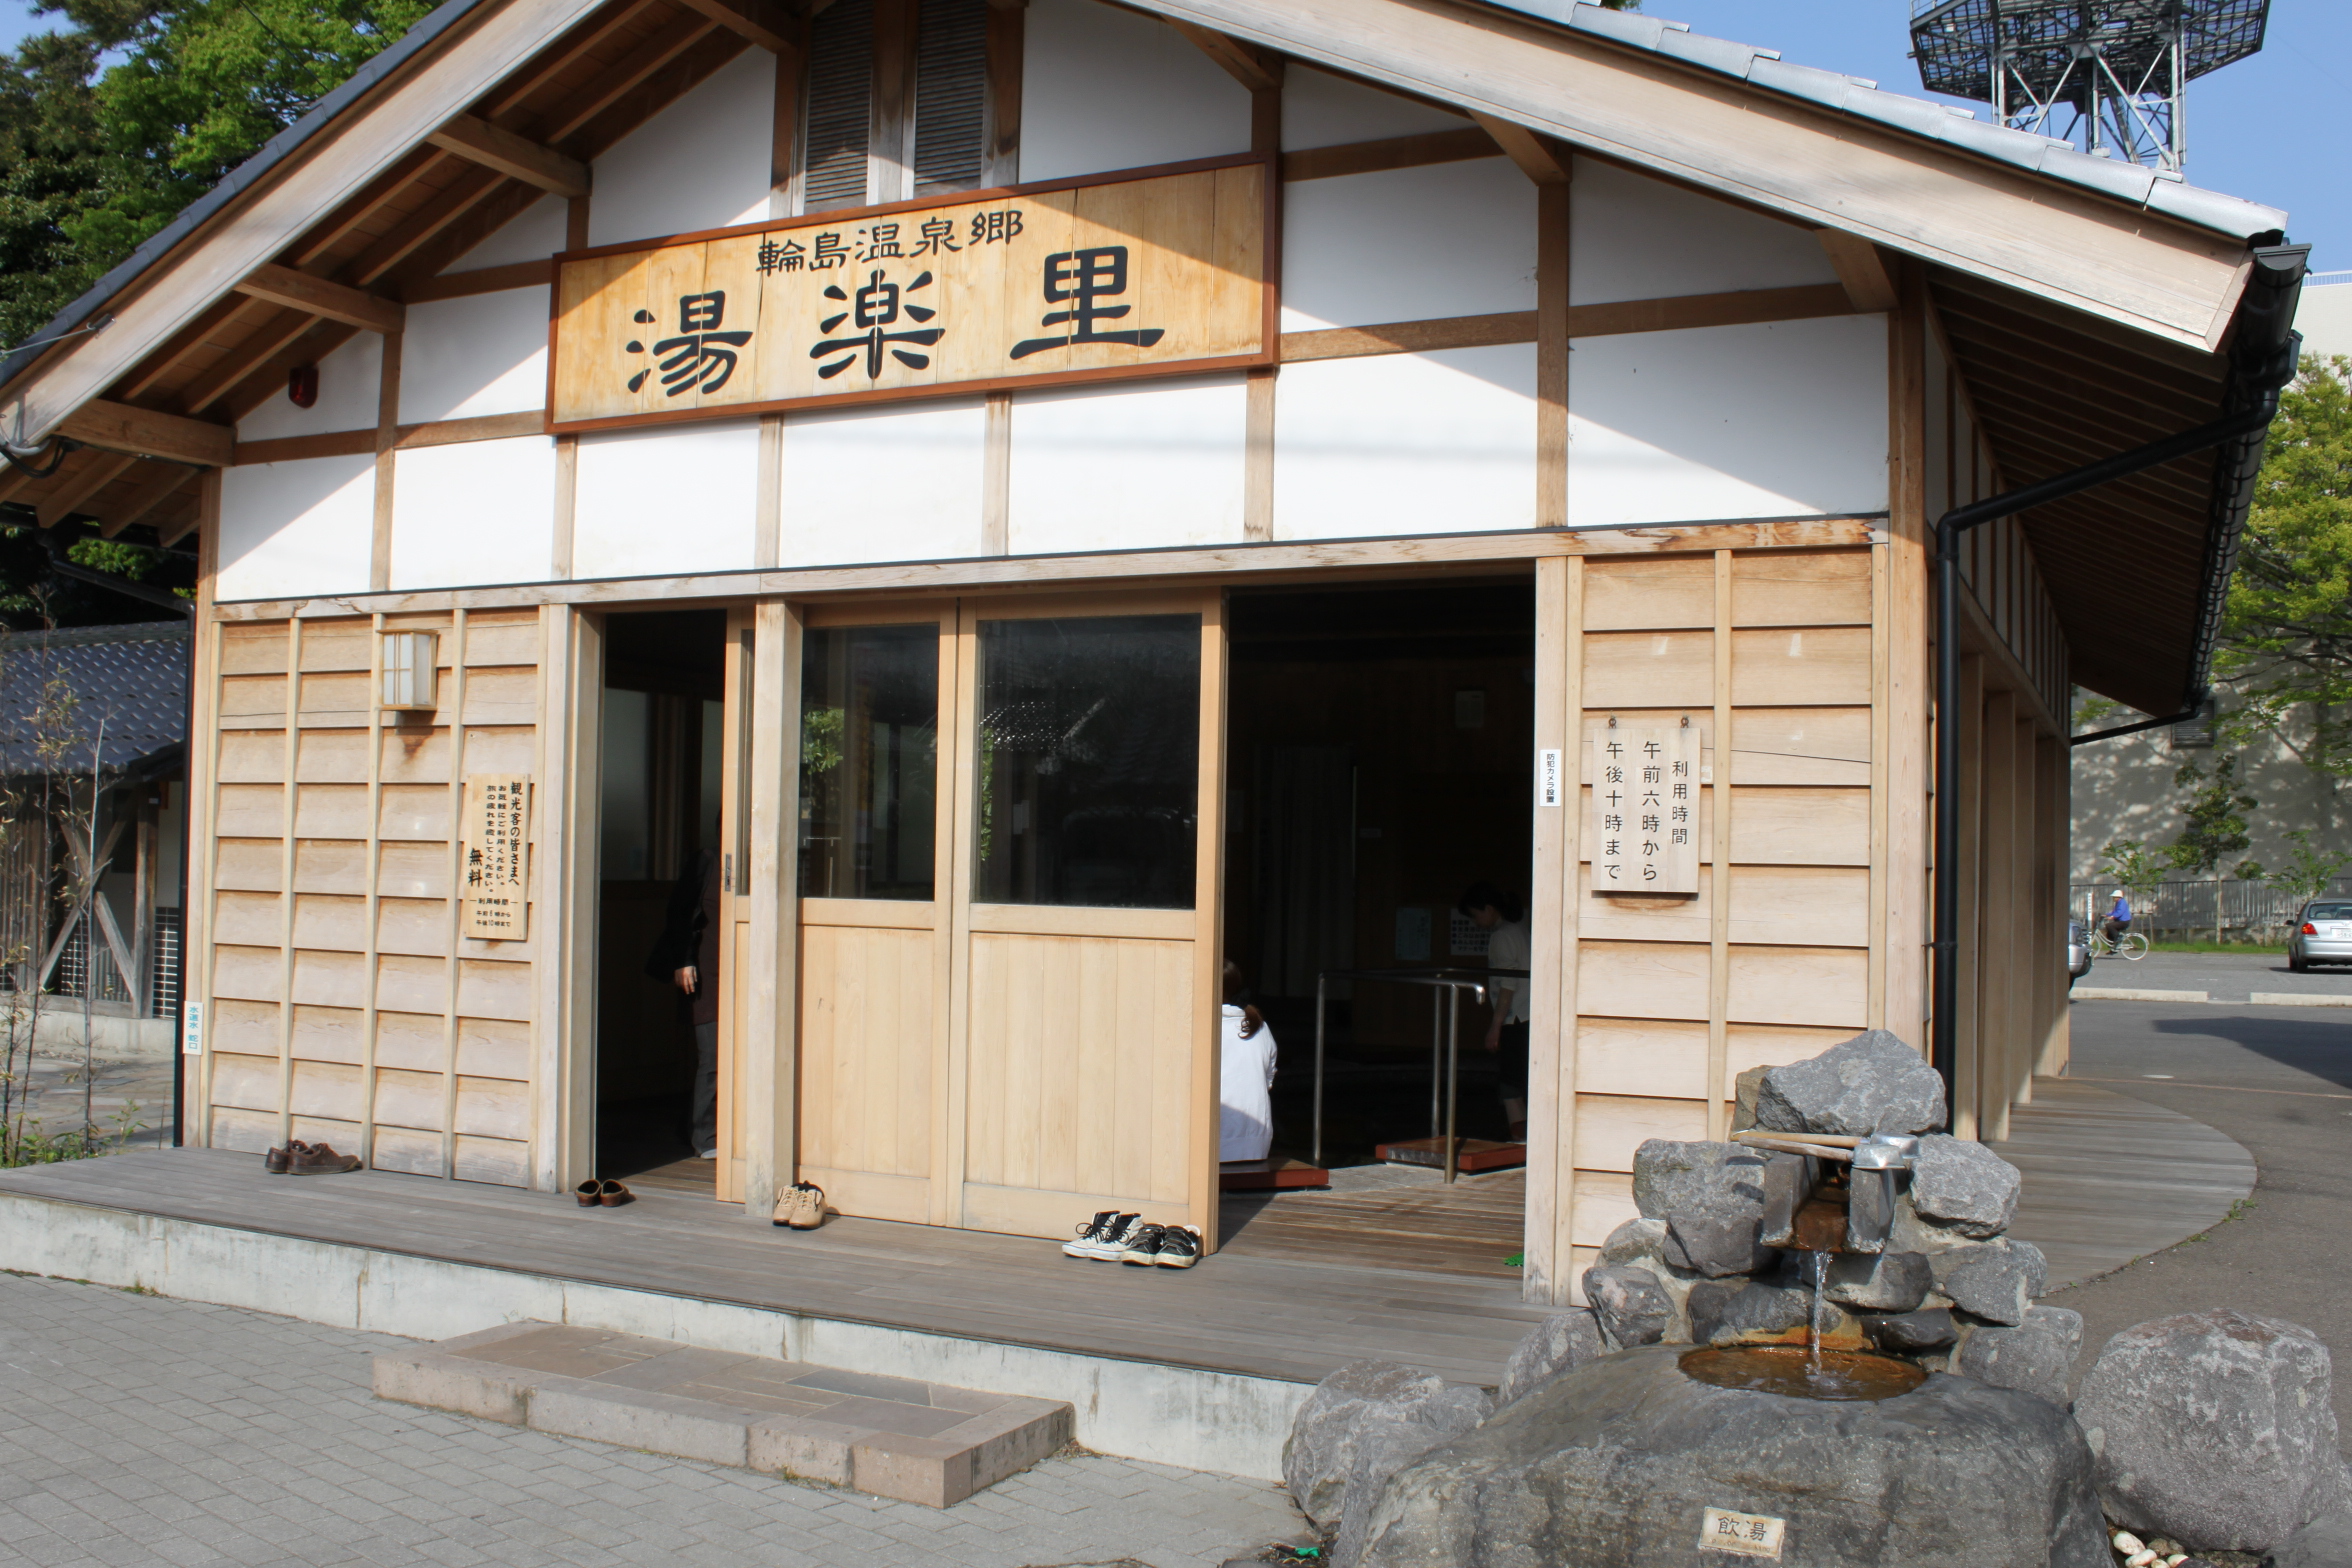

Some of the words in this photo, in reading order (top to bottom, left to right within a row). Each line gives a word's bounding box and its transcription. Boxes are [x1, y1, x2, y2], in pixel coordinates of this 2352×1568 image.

[755, 208, 1026, 278] 輪島温泉郷
[625, 244, 1166, 398] 湯楽里
[1546, 753, 1555, 803] 防犯カメラ設置
[1604, 741, 1624, 880] 午後十時まで
[1641, 740, 1661, 881] 午前六時から
[1671, 760, 1689, 845] 利用時間
[468, 848, 483, 888] 無料
[508, 781, 523, 886] 観光客の皆さまへ
[1717, 1516, 1767, 1542] 飲湯
